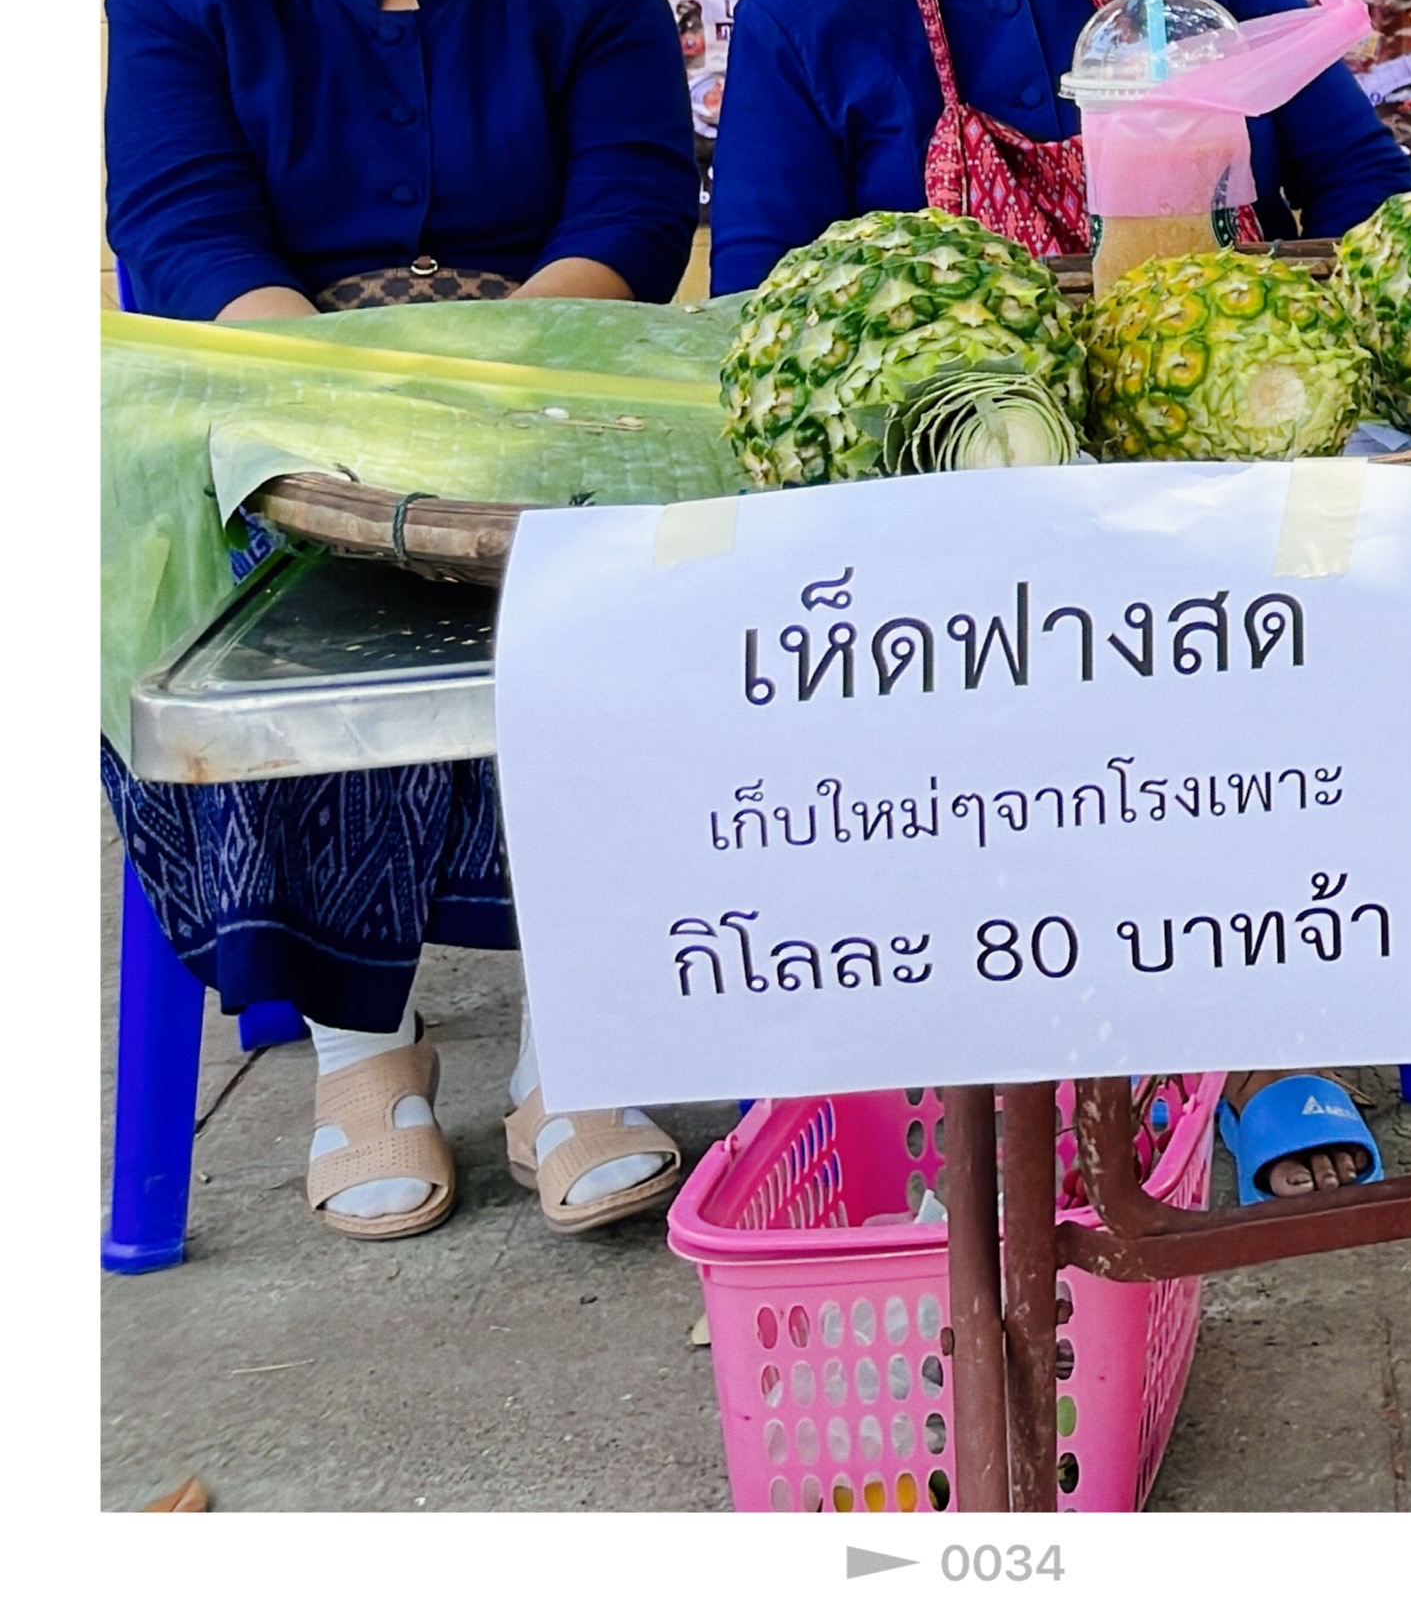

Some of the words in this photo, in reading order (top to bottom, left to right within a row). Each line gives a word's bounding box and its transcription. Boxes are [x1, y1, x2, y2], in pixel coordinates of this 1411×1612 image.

[743, 566, 1306, 707] เห็ดฟางสด
[668, 909, 933, 998] กิโลละ
[975, 914, 1080, 983] 80
[1115, 870, 1391, 974] บาทจ้า
